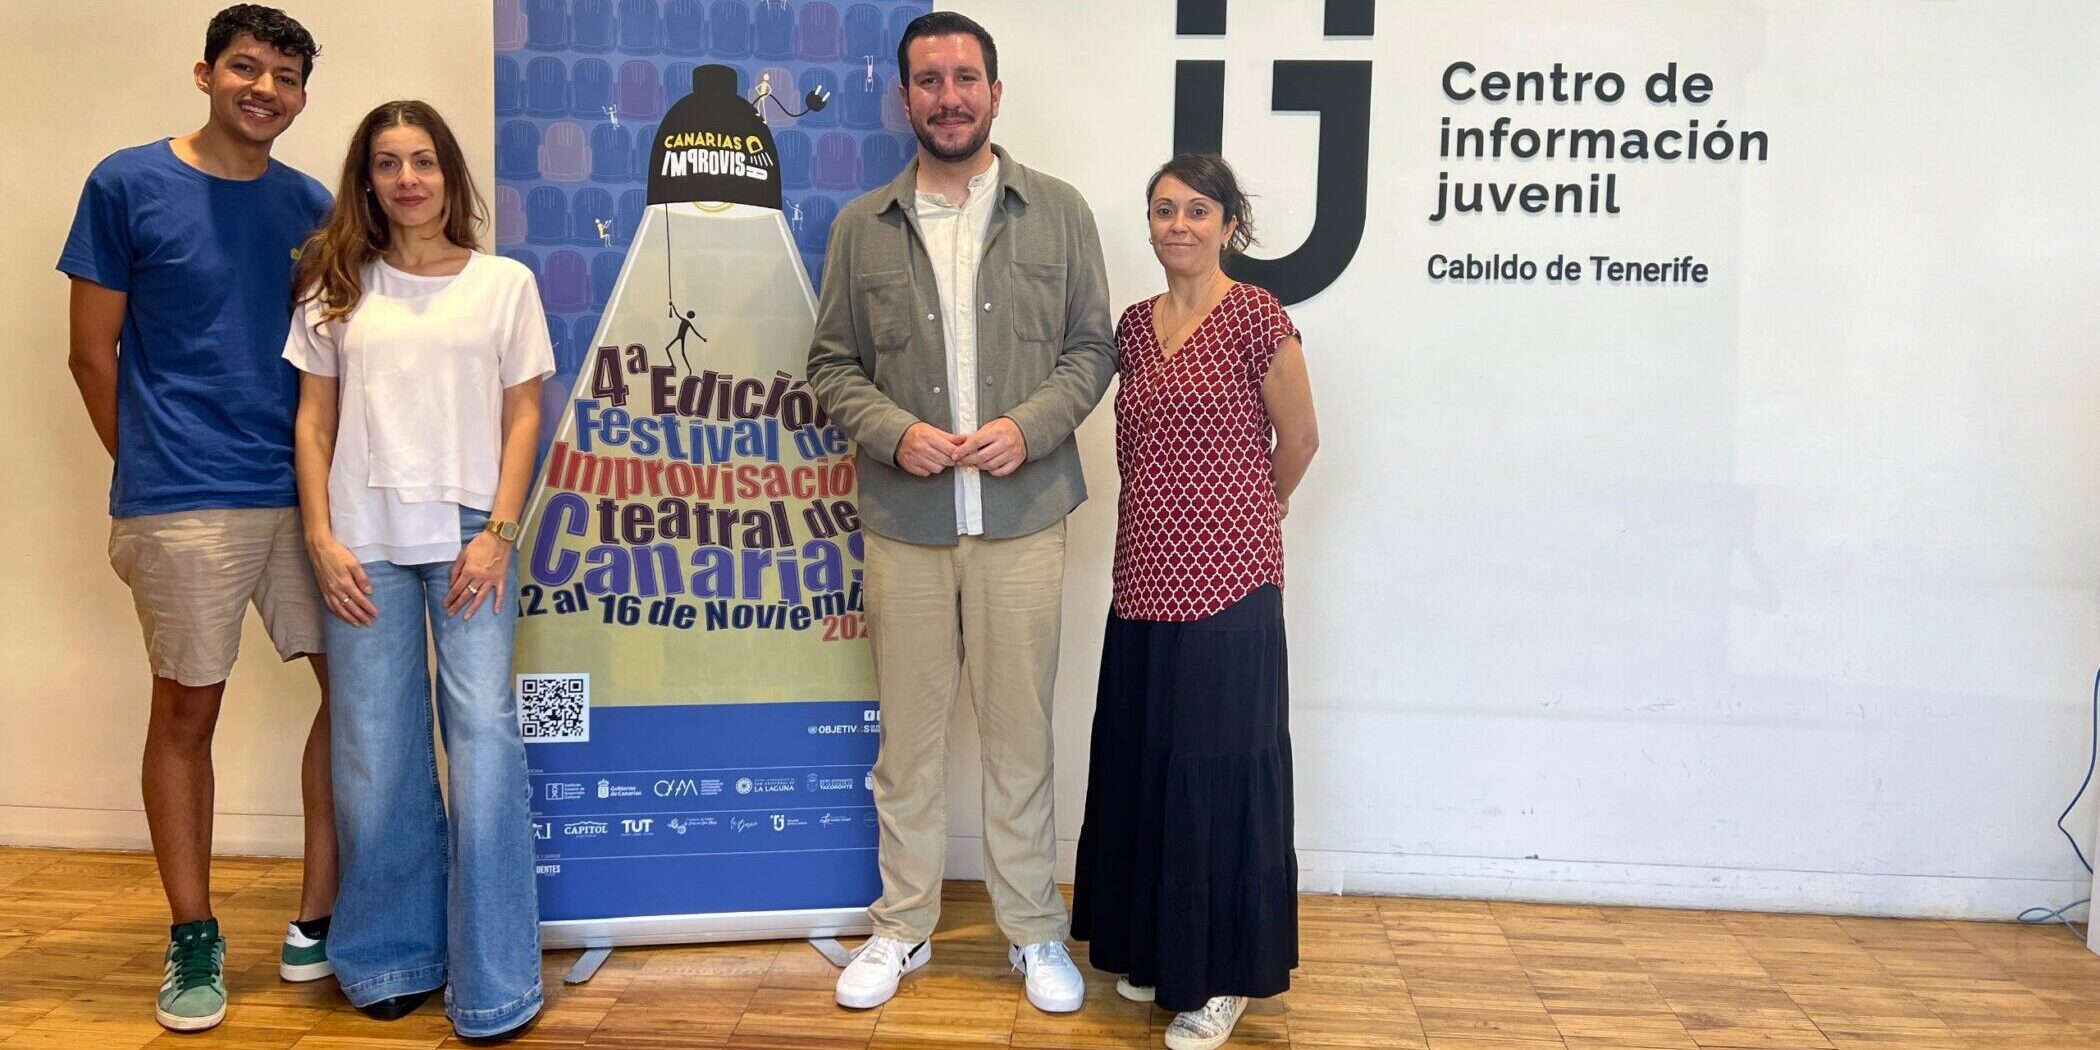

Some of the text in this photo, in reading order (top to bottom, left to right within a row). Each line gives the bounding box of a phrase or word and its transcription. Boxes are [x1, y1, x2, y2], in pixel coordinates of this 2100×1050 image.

[1442, 61, 1714, 104] Centro de
[664, 132, 742, 150] CANARIAS
[1440, 116, 1769, 161] información
[1428, 172, 1621, 221] juvenil
[1546, 254, 1582, 281] de
[1589, 255, 1709, 283] Tenerife
[573, 397, 849, 465] Festival de
[545, 440, 858, 504] Improvisació
[596, 496, 862, 550] teatral de
[552, 582, 590, 615] al
[598, 593, 642, 627] 16
[648, 596, 697, 630] de
[765, 784, 795, 793] LAGUNA
[564, 825, 608, 835] CAPITOL
[621, 819, 654, 833] TUT
